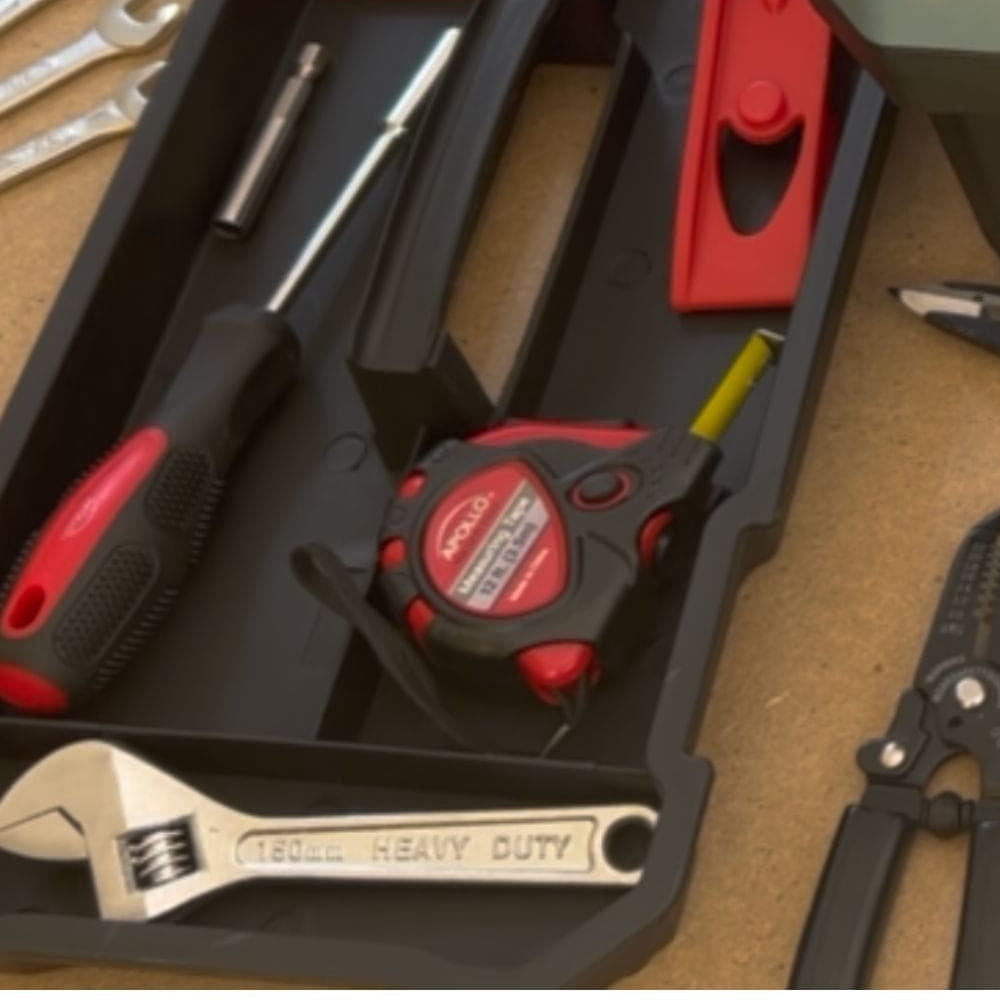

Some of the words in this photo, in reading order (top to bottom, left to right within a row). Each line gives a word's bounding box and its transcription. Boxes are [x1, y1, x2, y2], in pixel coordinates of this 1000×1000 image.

[443, 497, 489, 560] APOLLO
[372, 836, 471, 862] HEAVY
[491, 833, 572, 861] DUTY
